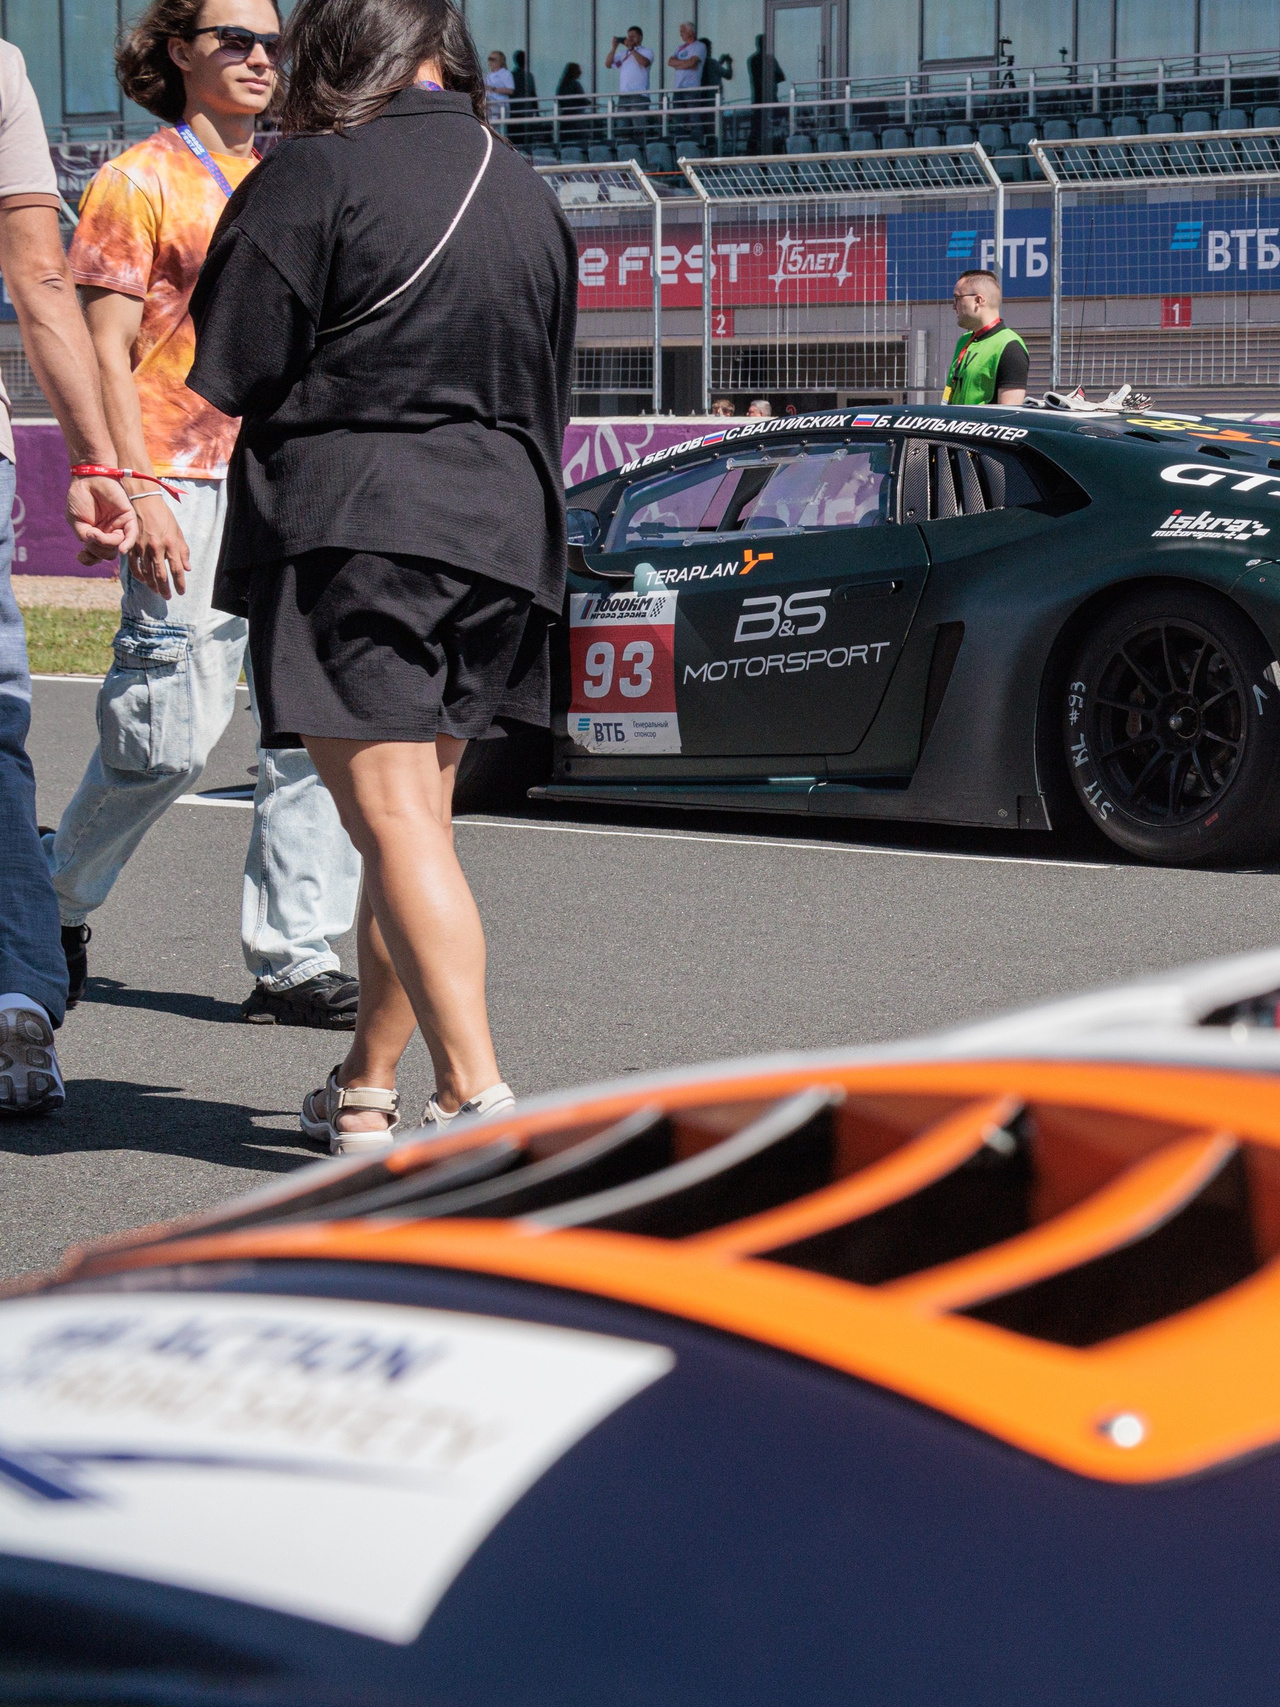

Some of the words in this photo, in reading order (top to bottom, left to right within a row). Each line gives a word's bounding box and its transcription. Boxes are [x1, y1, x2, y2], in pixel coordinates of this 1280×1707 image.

[1207, 227, 1280, 272] ВТБ
[715, 313, 727, 335] 2
[1172, 303, 1180, 325] 1
[1160, 509, 1254, 533] iskra
[1151, 529, 1237, 540] motorsport
[645, 561, 739, 587] TERAPLAN
[733, 588, 832, 643] B&S
[583, 640, 656, 699] 93
[683, 641, 891, 685] MOTORSPORT
[593, 722, 626, 743] ВТБ
[632, 720, 669, 729] Генеральный
[633, 730, 657, 740] спонсор
